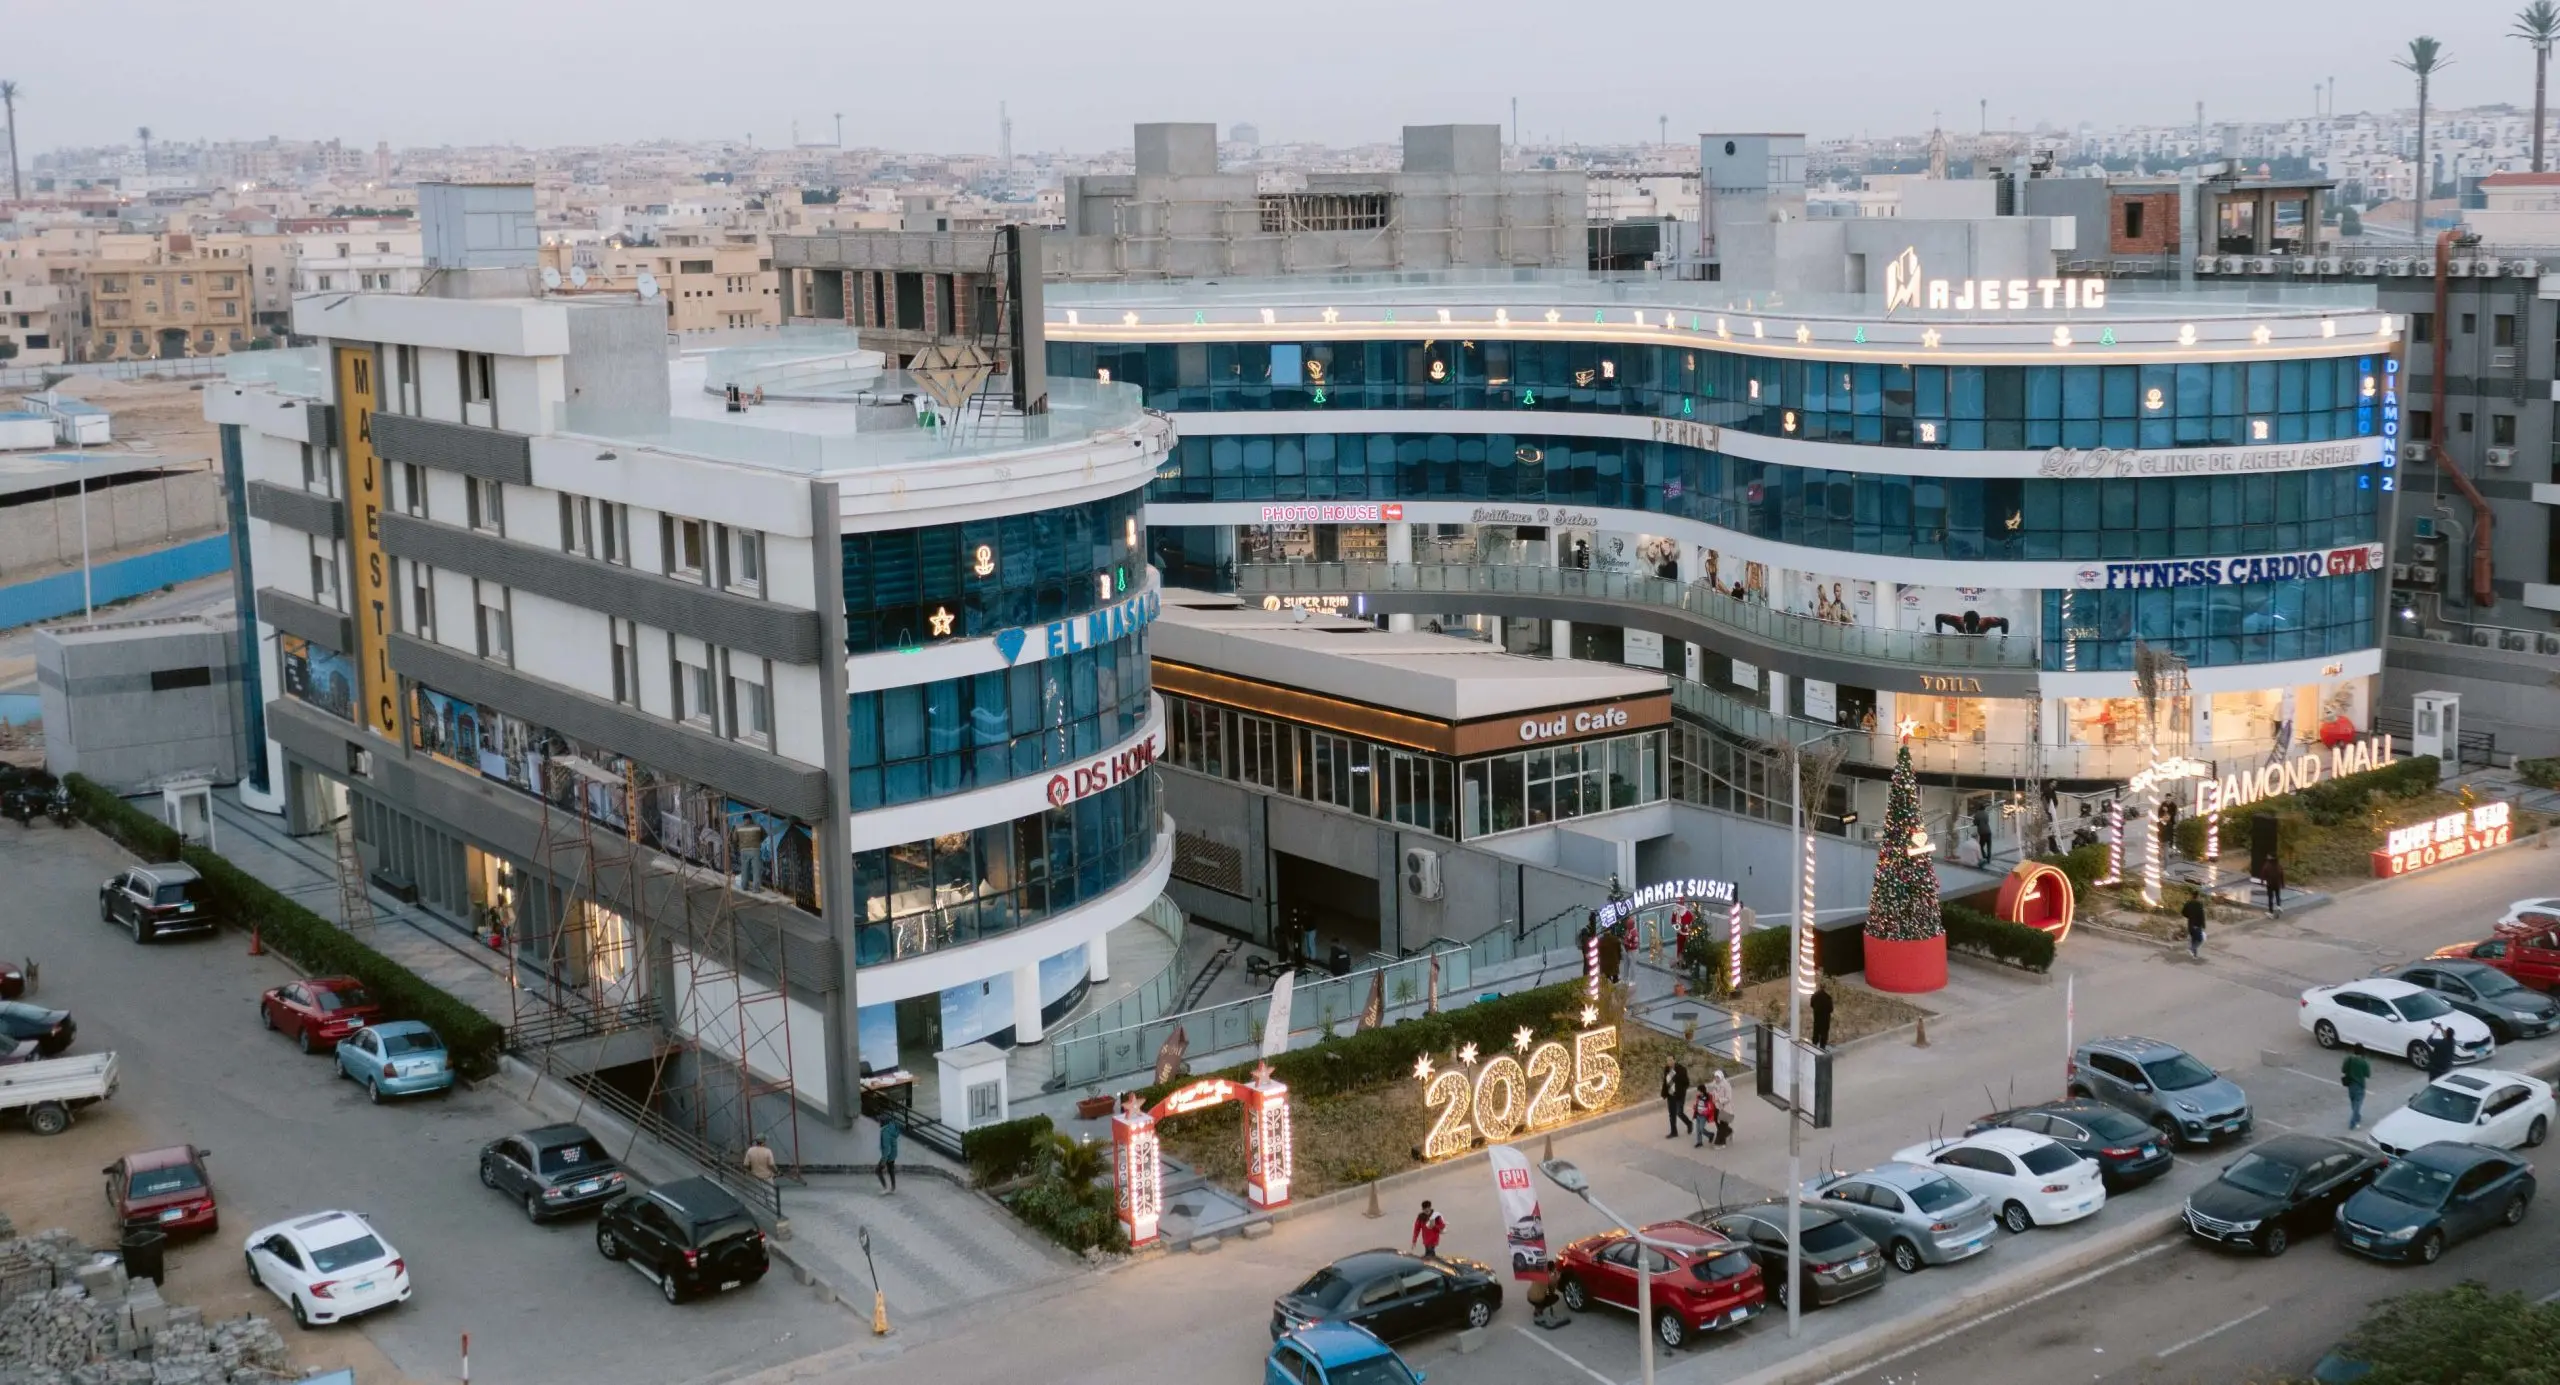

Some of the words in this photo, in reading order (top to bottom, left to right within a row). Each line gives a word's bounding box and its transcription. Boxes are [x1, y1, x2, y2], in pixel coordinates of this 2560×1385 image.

[1886, 246, 2105, 319] MAJESTIC
[2383, 359, 2399, 468] DIAMOND
[2138, 453, 2205, 474] CLINIC
[2208, 453, 2235, 472] DR
[2239, 450, 2298, 470] AREEJ
[2382, 476, 2394, 491] 2
[1262, 506, 1318, 522] PHOTO
[1322, 505, 1379, 521] HOUSE
[1552, 508, 1598, 526] Salon
[354, 359, 393, 730] MAJESTIC
[2106, 559, 2222, 590] FITNESS
[2228, 552, 2323, 585] CARDIO
[2326, 547, 2369, 576] GYM
[1283, 596, 1320, 608] SUPER
[1322, 596, 1349, 608] TRIM
[1046, 619, 1083, 657] EL
[1919, 675, 1983, 693] VOILA
[2131, 677, 2193, 690] VILA
[1519, 715, 1567, 741] Oud
[1575, 708, 1628, 732] Cafe
[1074, 761, 1108, 798] DS
[1112, 733, 1156, 784] HOME
[2195, 754, 2321, 817] DIAMOND
[2331, 734, 2398, 779] MALL
[1633, 880, 1684, 908] WAKAI
[1686, 879, 1736, 901] SUSHI
[1425, 1024, 1621, 1159] 2025
